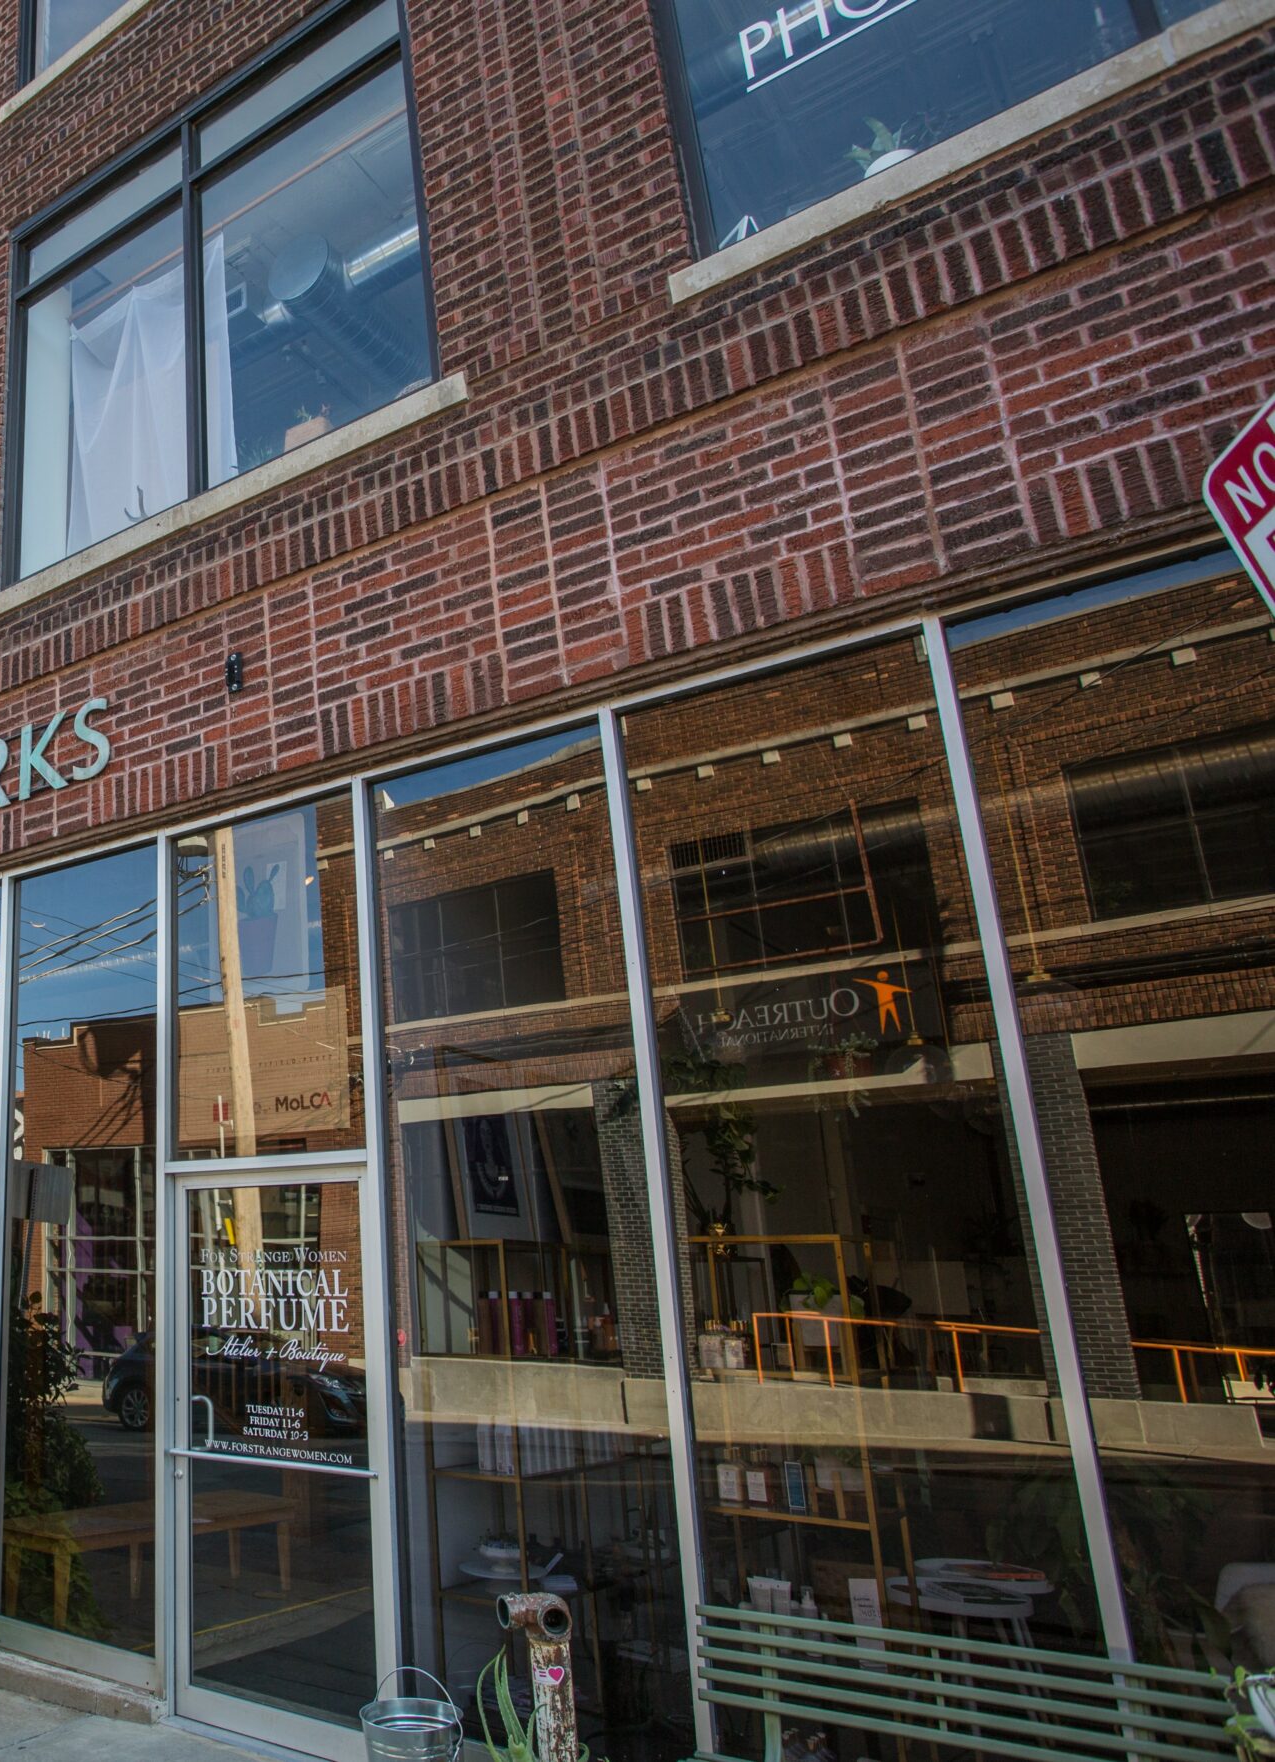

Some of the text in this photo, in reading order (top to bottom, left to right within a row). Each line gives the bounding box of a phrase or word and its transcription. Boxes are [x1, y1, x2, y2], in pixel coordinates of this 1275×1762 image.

[201, 1269, 348, 1297] BOTANICAL
[201, 1297, 349, 1332] PERFUME
[206, 1335, 261, 1357] Atelier
[279, 1338, 346, 1373] Boutique
[245, 1404, 305, 1418] TUESDAY 11-6
[249, 1416, 301, 1430] FRIDAY 11-6
[242, 1426, 309, 1442] SATURDAY 10-3
[204, 1438, 353, 1465] WWW.FORSTRANGEWOMEN.COM
